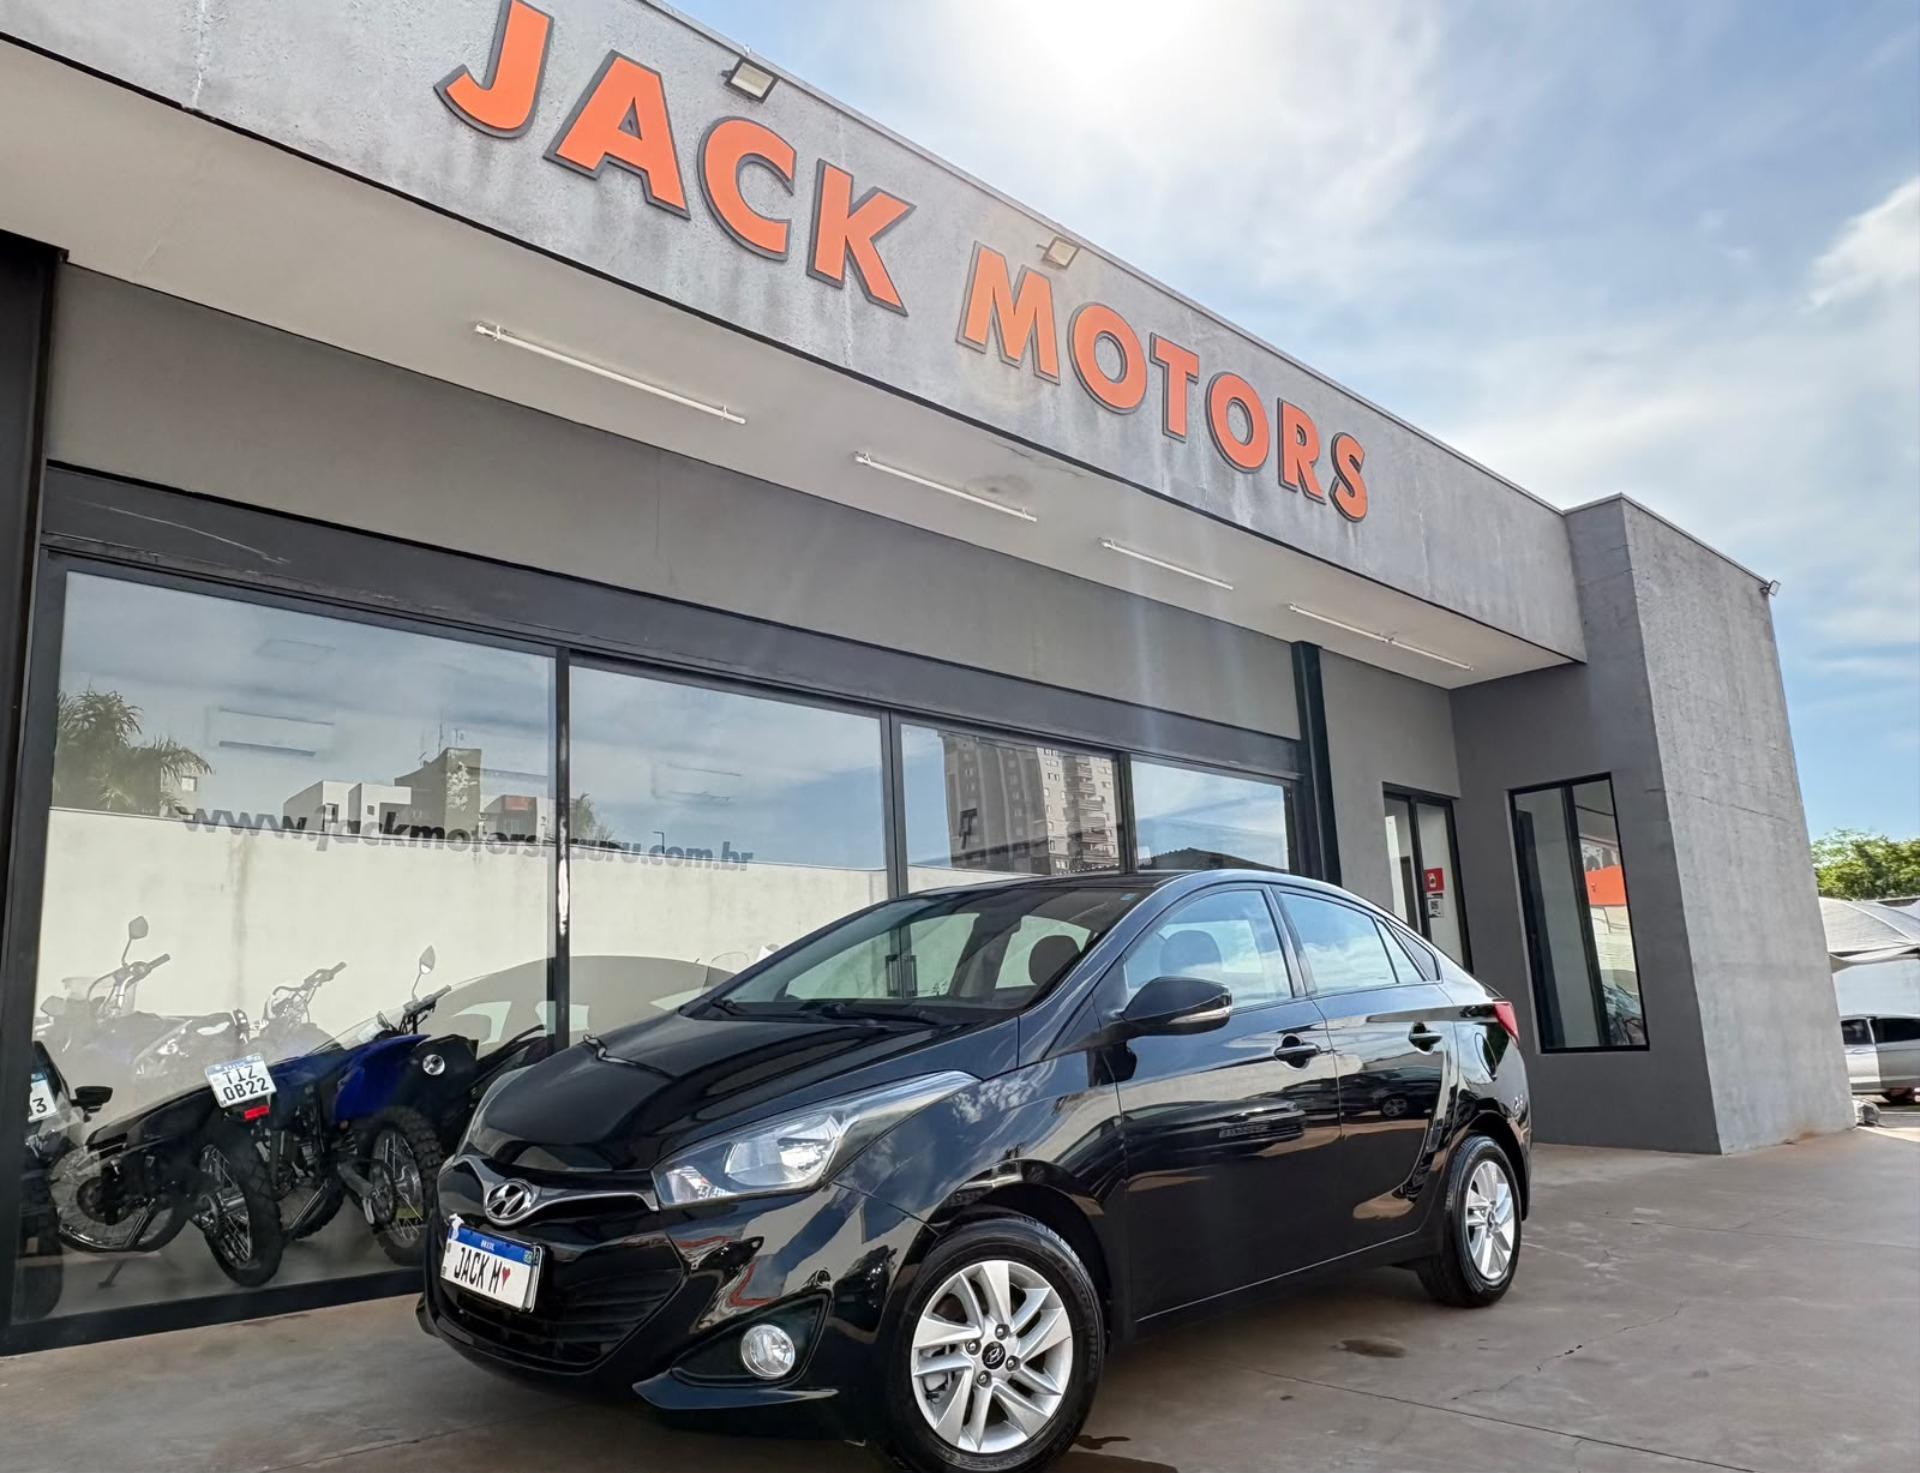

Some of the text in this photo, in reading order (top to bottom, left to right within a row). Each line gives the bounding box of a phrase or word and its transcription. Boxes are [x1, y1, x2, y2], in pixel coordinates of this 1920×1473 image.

[434, 0, 1368, 522] JACK MOTORS
[183, 806, 754, 872] www.jackmotorsauru.com.br
[454, 1246, 490, 1290] JACK
